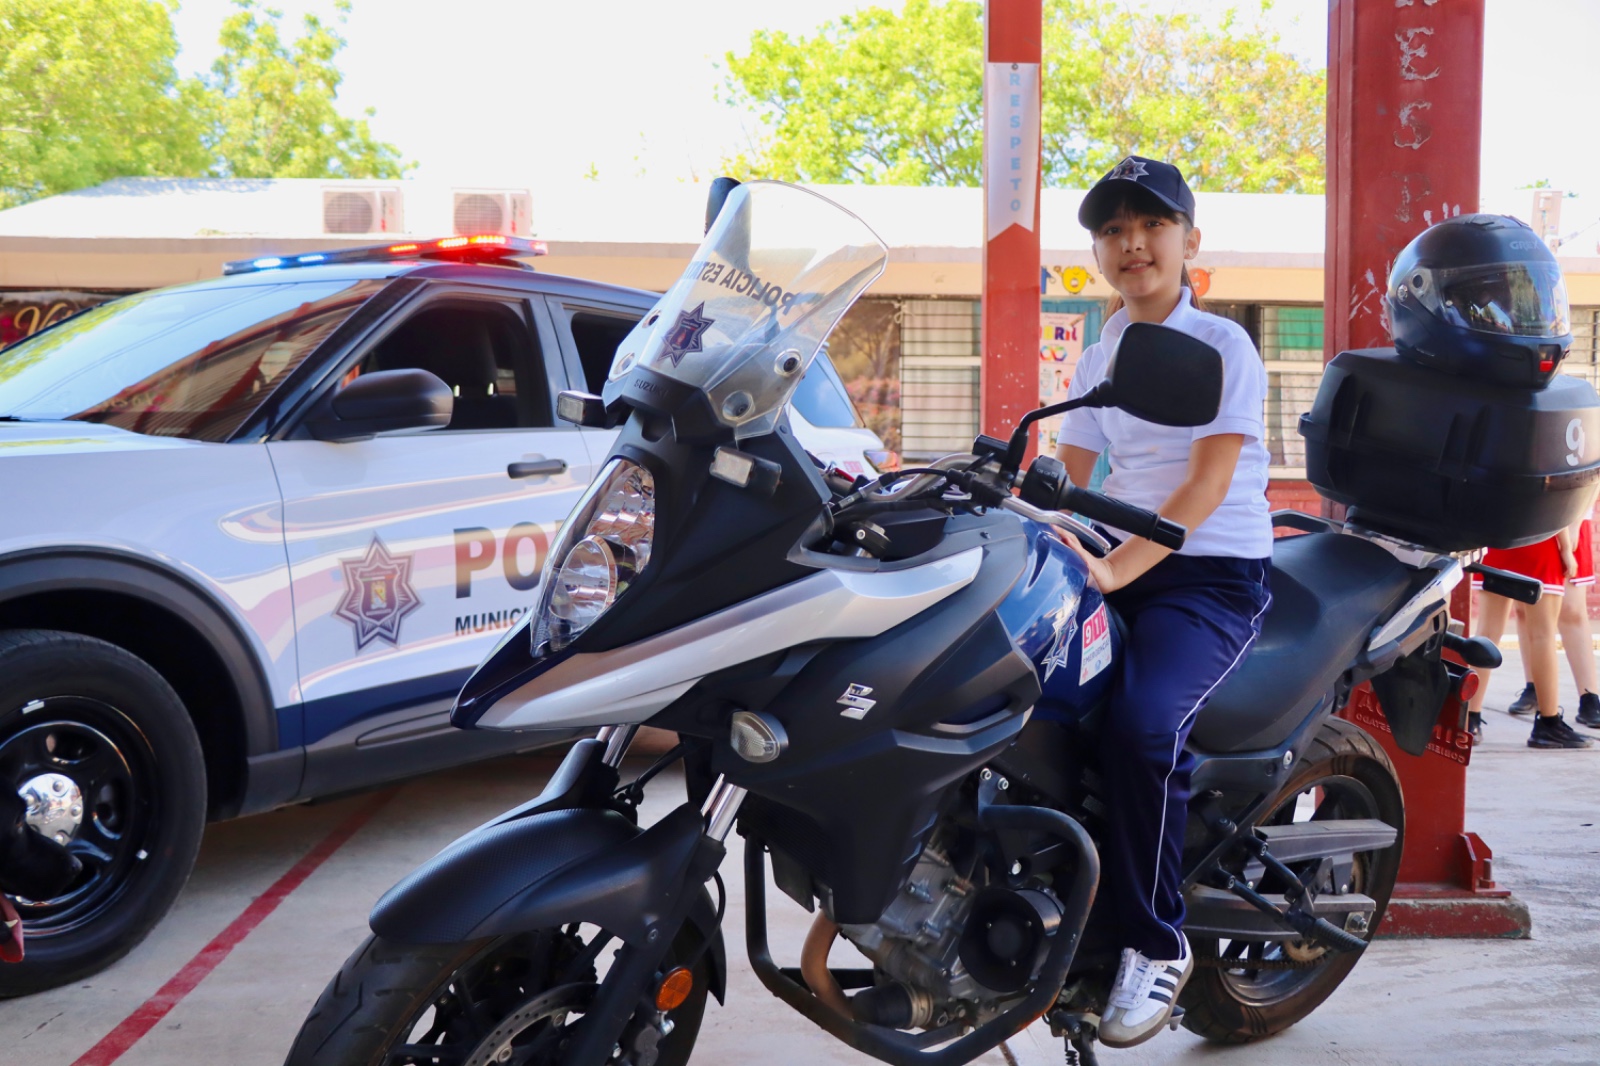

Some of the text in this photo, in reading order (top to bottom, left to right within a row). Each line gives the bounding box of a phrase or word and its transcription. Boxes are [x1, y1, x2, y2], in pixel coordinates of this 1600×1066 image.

[1009, 72, 1022, 212] RESPETO
[1509, 239, 1540, 251] GREX
[1565, 418, 1585, 466] 9
[453, 519, 565, 599] PO
[1085, 606, 1107, 645] 911
